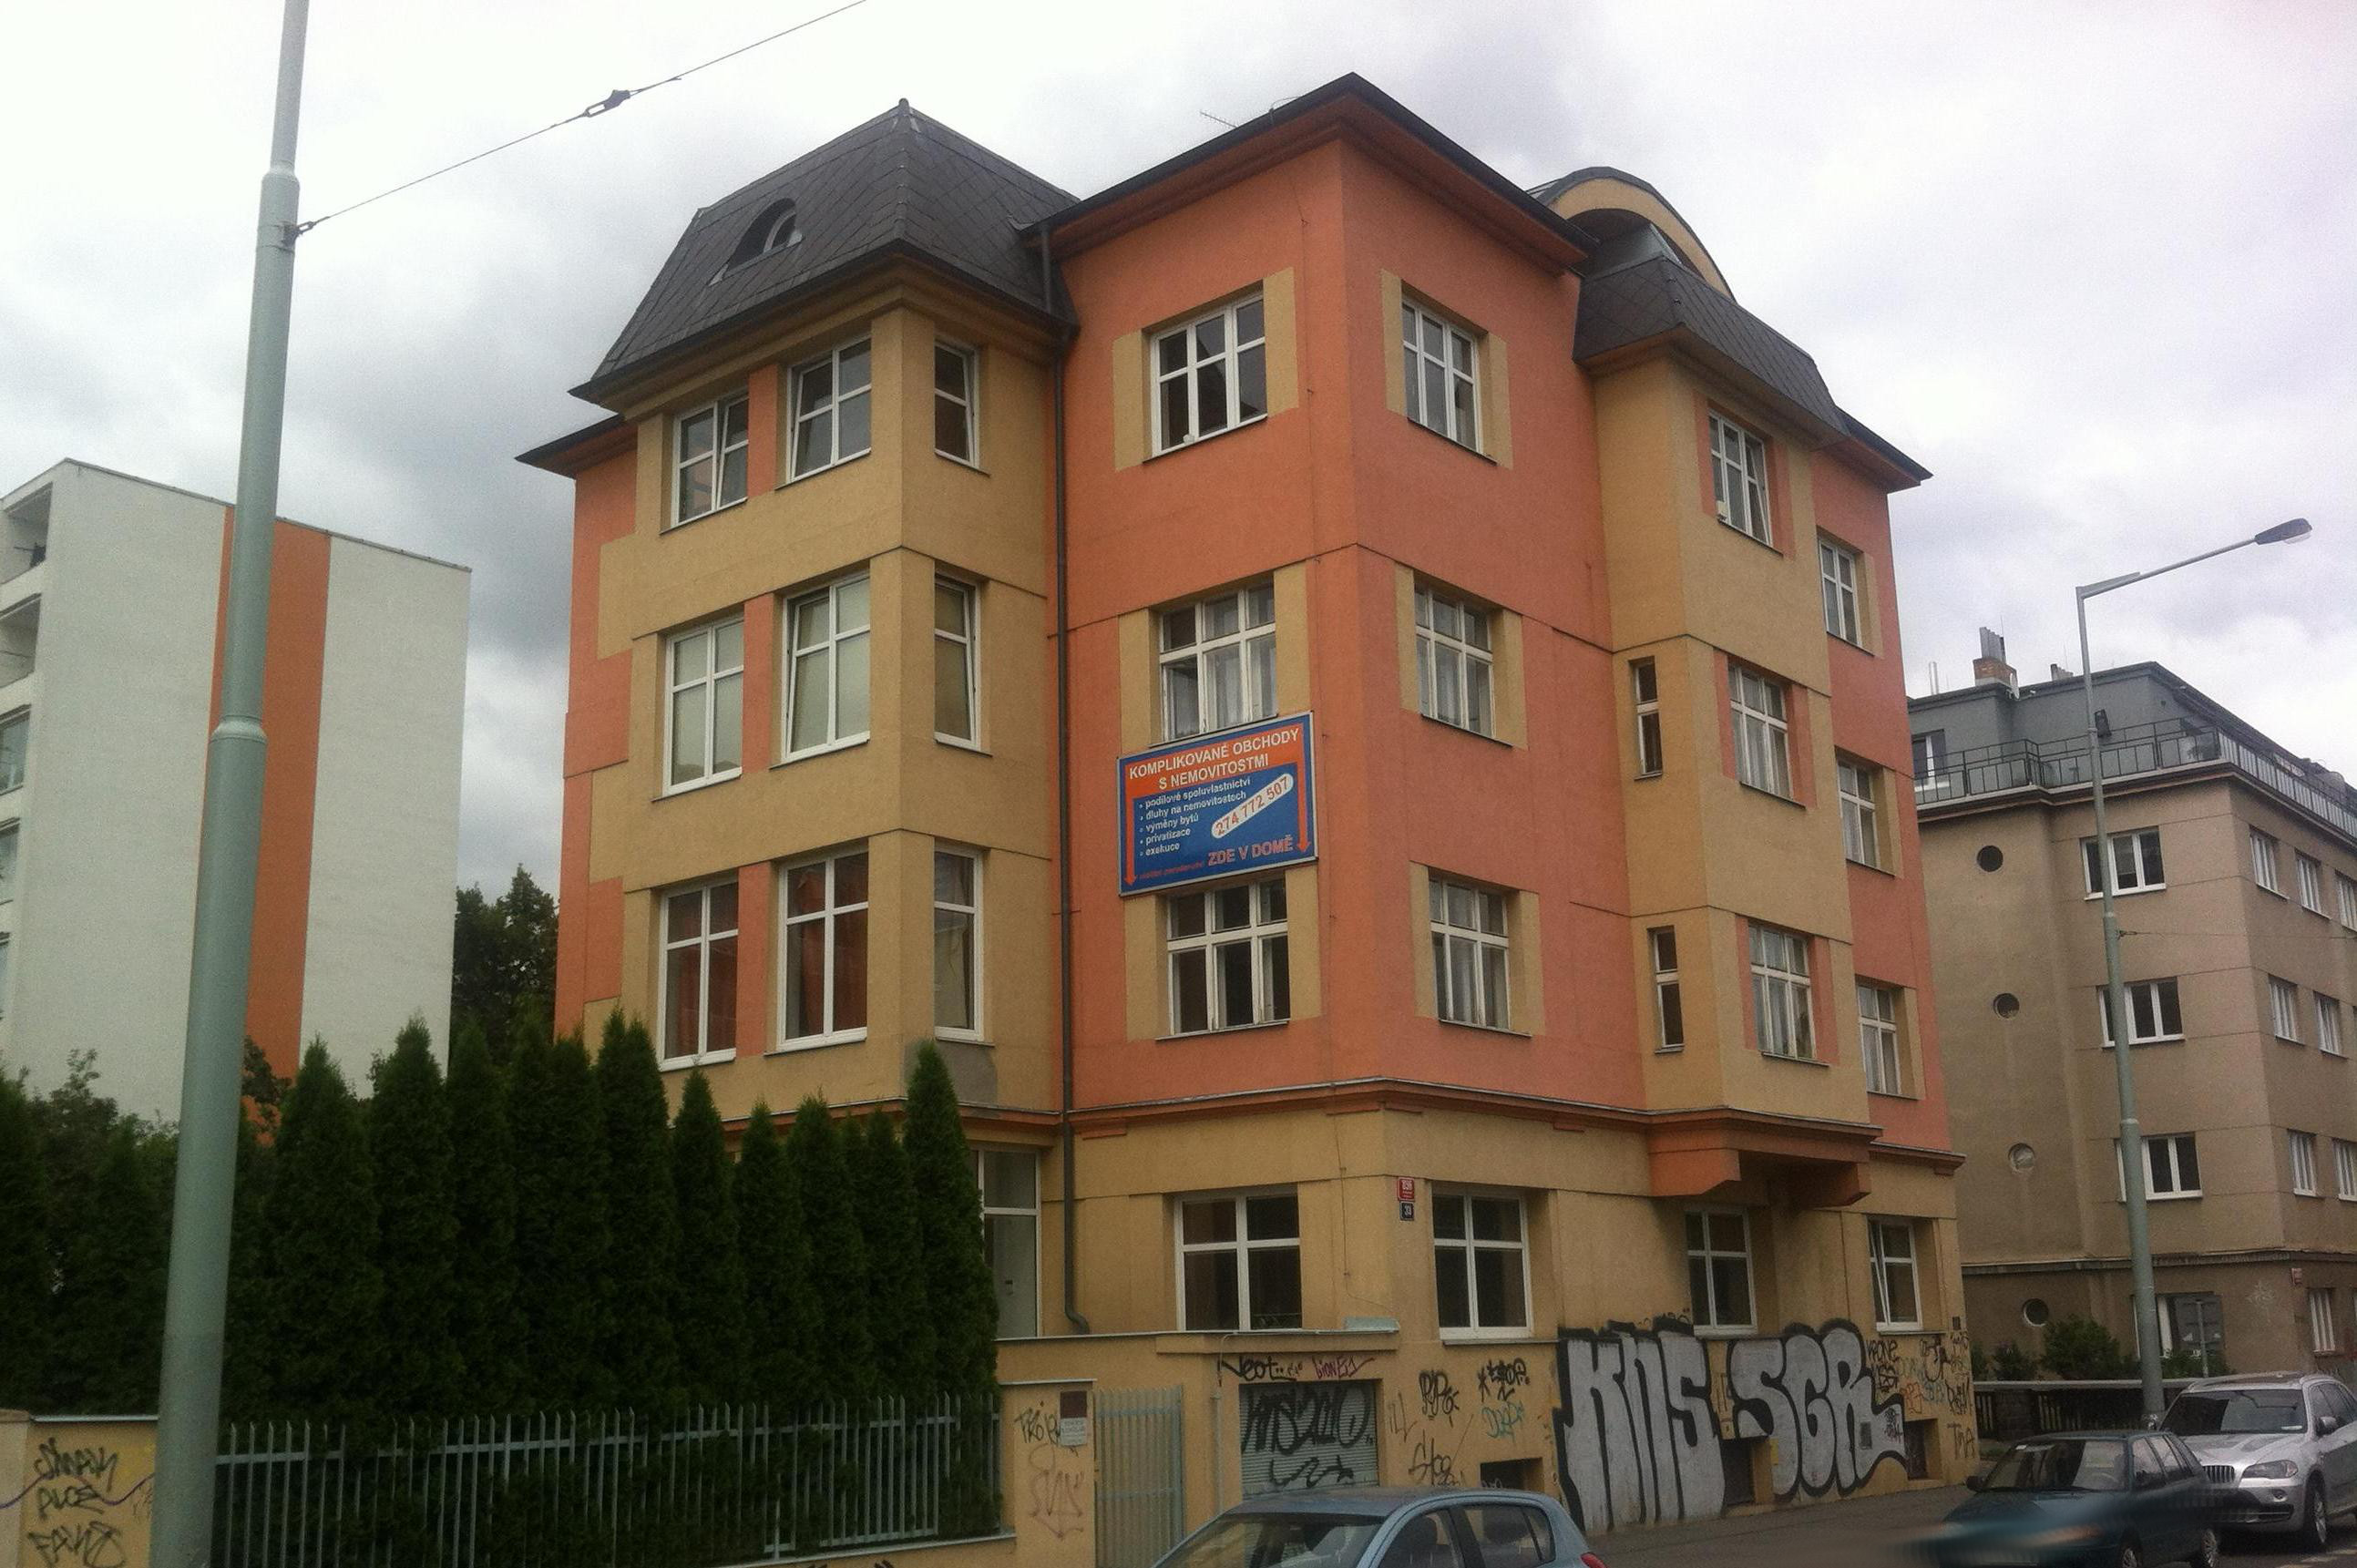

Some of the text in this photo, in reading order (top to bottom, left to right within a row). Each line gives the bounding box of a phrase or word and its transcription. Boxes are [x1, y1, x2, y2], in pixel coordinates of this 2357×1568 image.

[1129, 728, 1300, 780] KOMPLIKOVANÉ OBCHODY
[1159, 753, 1269, 790] S NEMOVITOSTMI
[1171, 805, 1182, 815] na
[1215, 775, 1288, 836] 274 772 507
[1145, 828, 1192, 845] privatizace
[1145, 842, 1180, 856] exekuce
[1208, 834, 1294, 866] ZDE V DOMĚ
